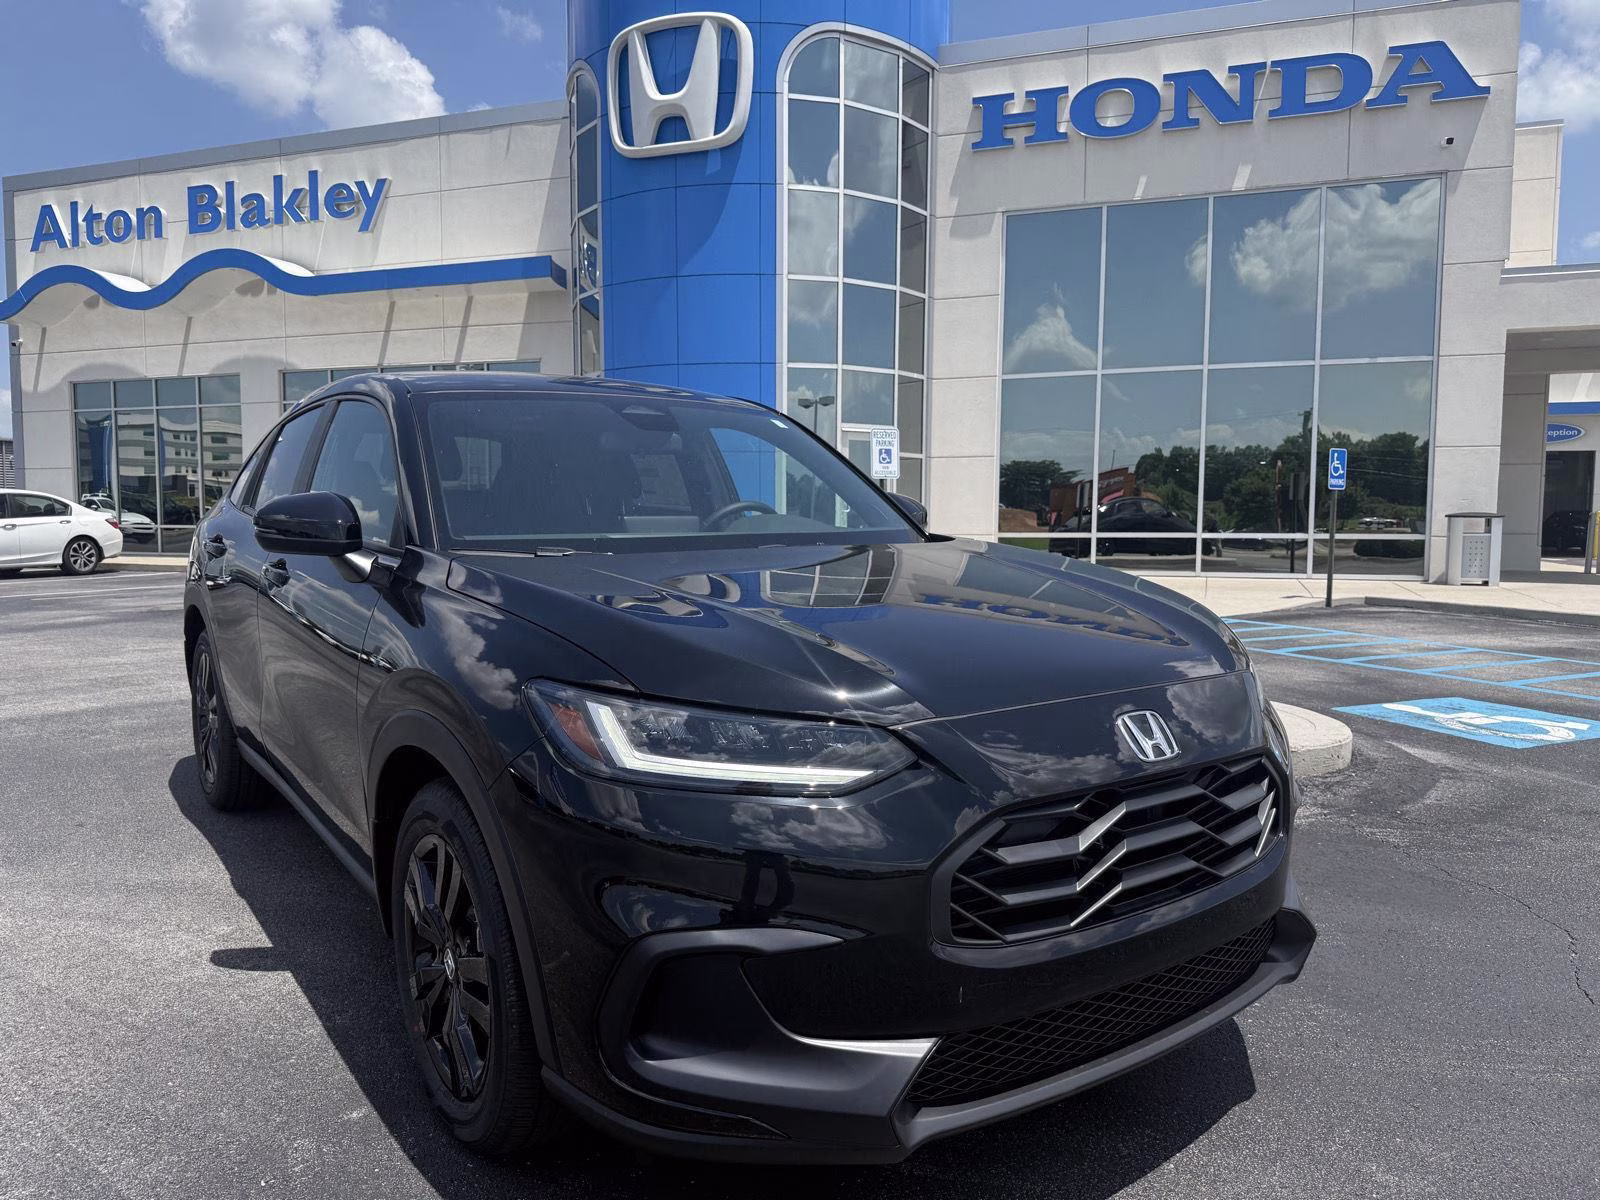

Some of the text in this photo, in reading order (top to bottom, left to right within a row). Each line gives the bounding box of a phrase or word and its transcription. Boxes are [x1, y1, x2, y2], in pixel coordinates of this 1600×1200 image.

[972, 40, 1490, 150] HONDA
[30, 170, 391, 252] Alton Blakley
[873, 431, 896, 439] RESERVED
[1547, 429, 1578, 437] eption
[875, 439, 895, 447] PARKING
